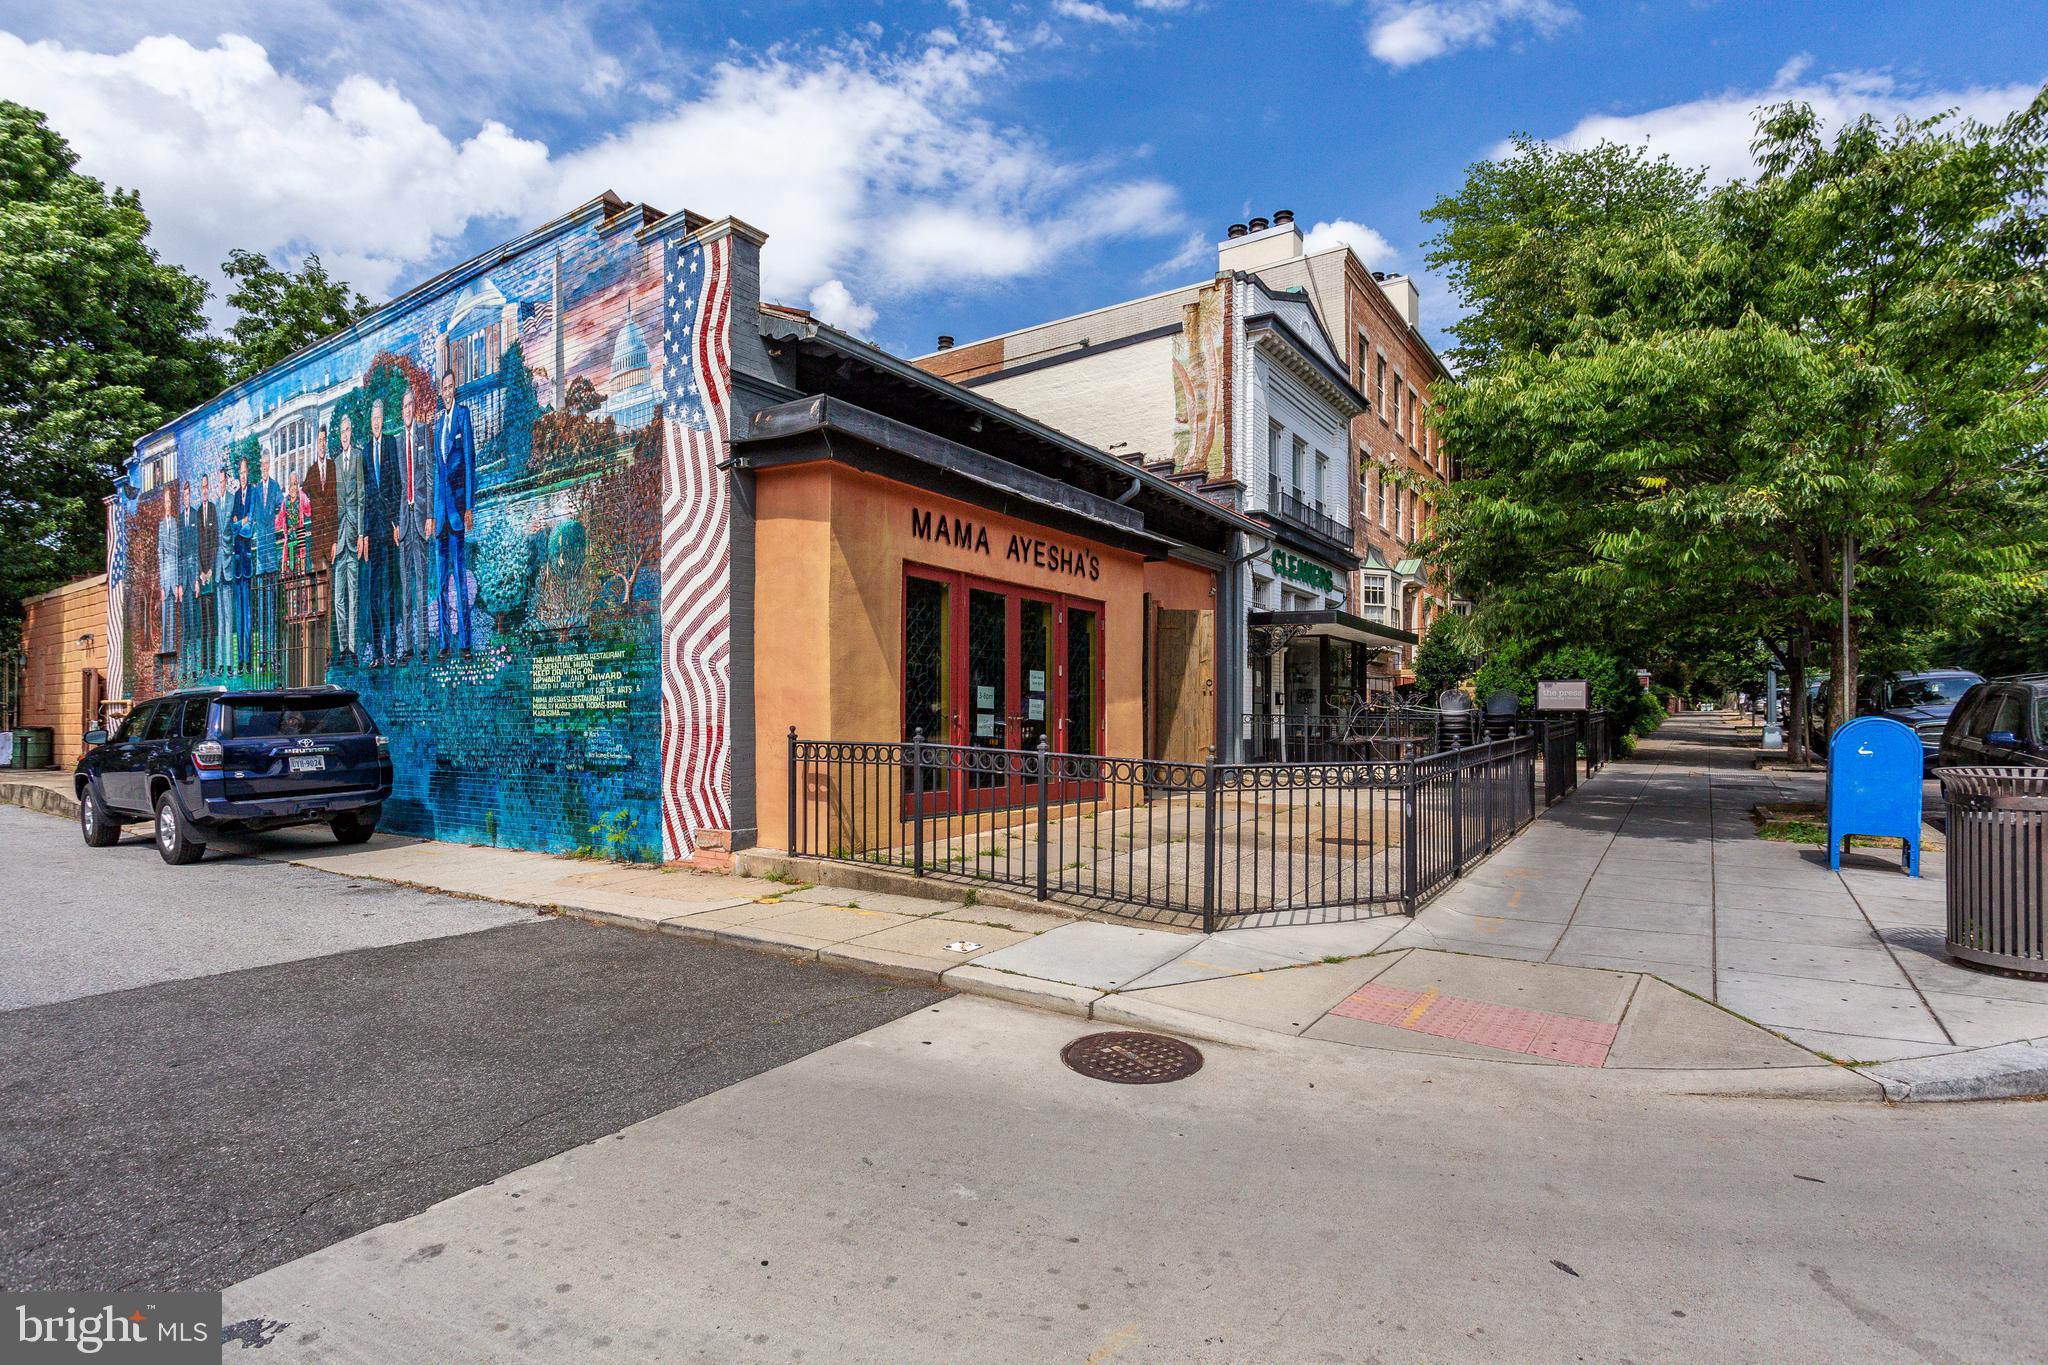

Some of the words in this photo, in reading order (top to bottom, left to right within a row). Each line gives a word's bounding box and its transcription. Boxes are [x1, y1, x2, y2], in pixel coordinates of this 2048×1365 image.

[912, 507, 990, 555] MAMA
[1007, 534, 1100, 581] AYESHA'S
[1271, 549, 1333, 592] CLEANERS
[617, 685, 633, 693] ARTS
[1543, 688, 1557, 697] the
